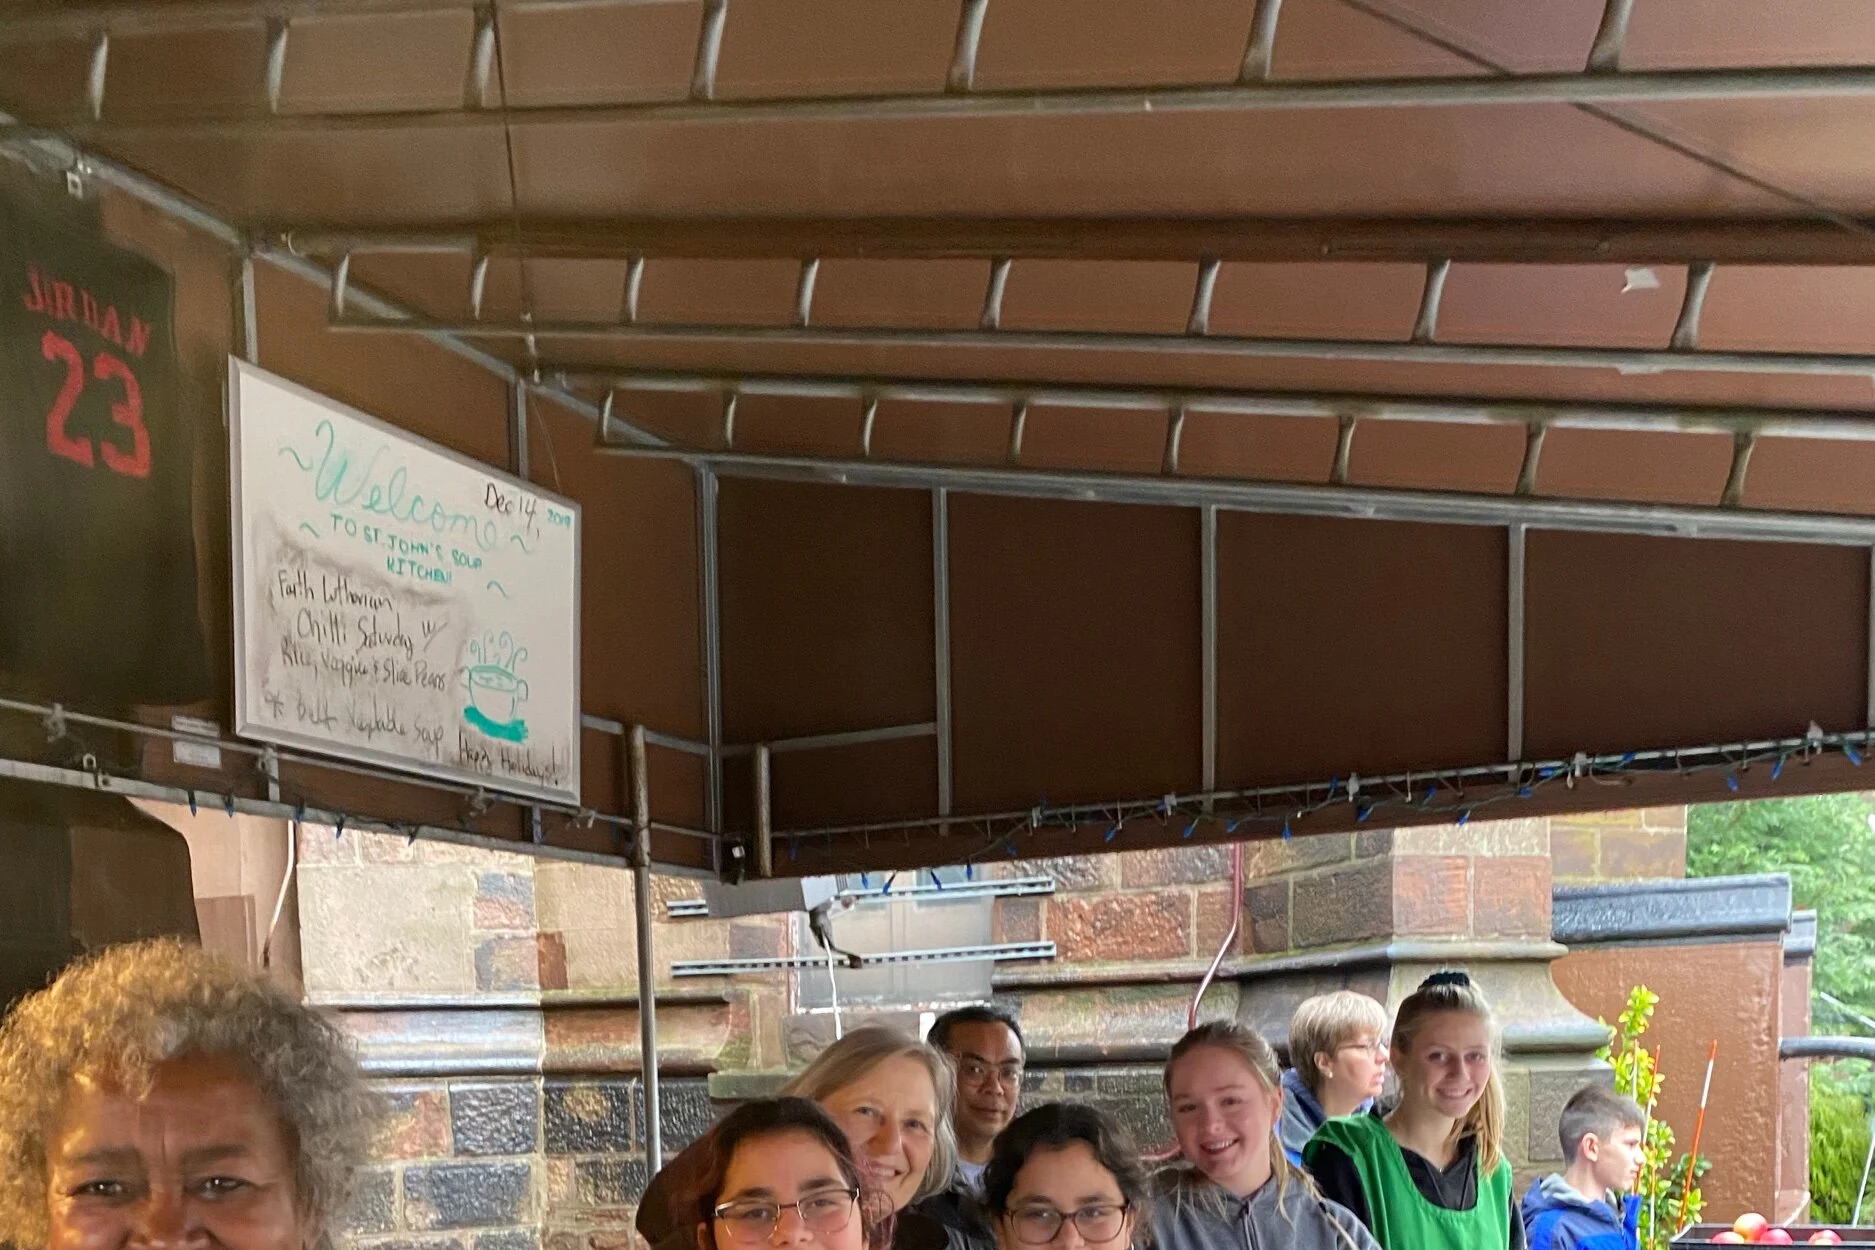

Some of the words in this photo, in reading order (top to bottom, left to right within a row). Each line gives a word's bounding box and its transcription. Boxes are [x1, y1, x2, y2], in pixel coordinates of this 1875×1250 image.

[41, 329, 152, 478] 23
[314, 419, 498, 552] Welcome
[484, 482, 514, 516] Dec
[547, 508, 571, 530] 2019
[330, 513, 357, 537] TO
[388, 533, 444, 562] JOHN'S
[451, 549, 483, 570] SOUP
[278, 569, 315, 600] Faith
[297, 606, 347, 647] Chilli
